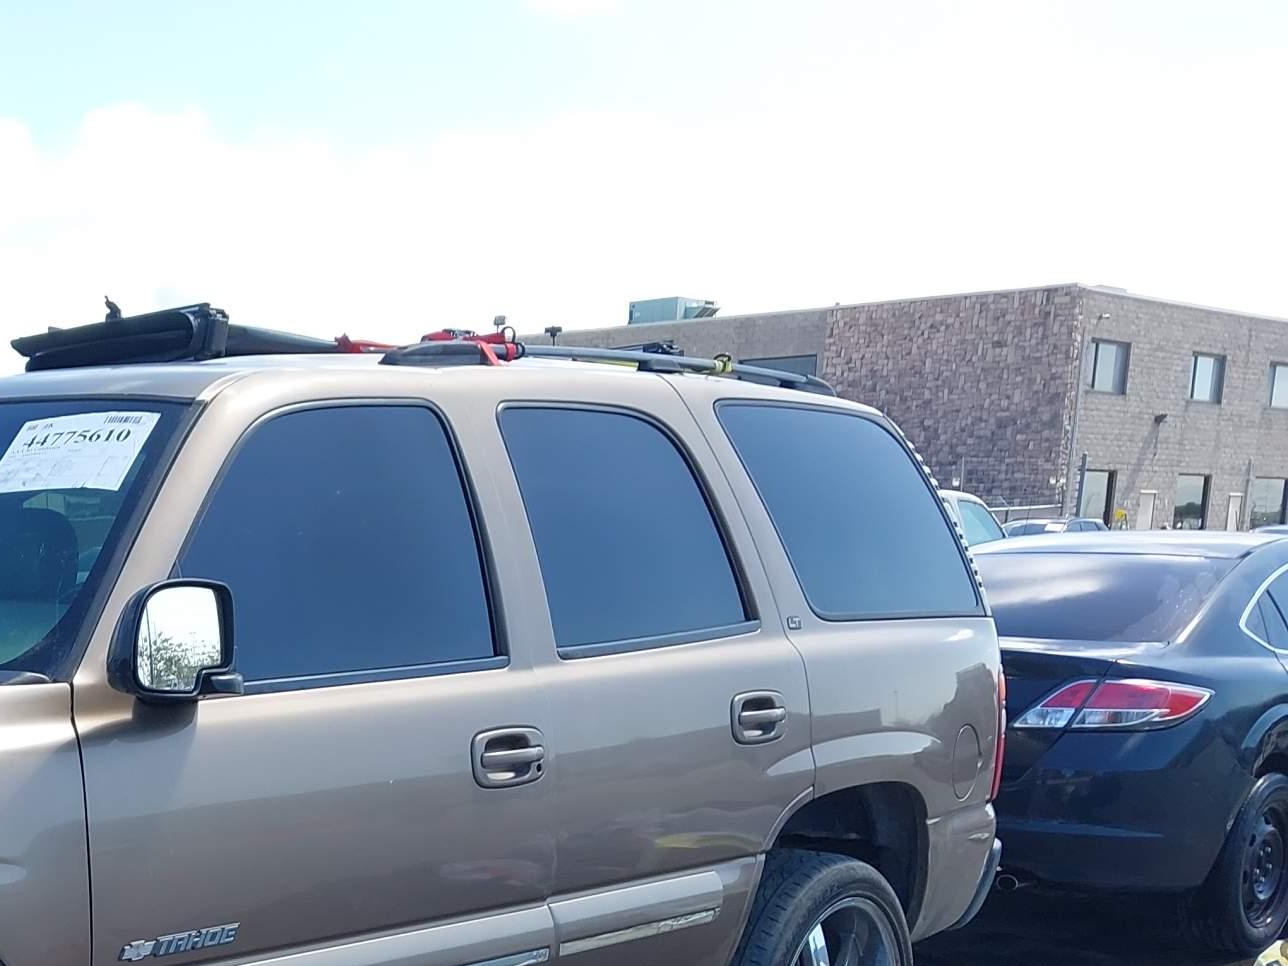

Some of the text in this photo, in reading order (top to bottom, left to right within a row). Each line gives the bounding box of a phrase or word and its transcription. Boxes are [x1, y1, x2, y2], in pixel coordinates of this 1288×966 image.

[23, 428, 131, 448] 44775610
[788, 617, 801, 629] LT
[155, 922, 241, 957] TAHOE
